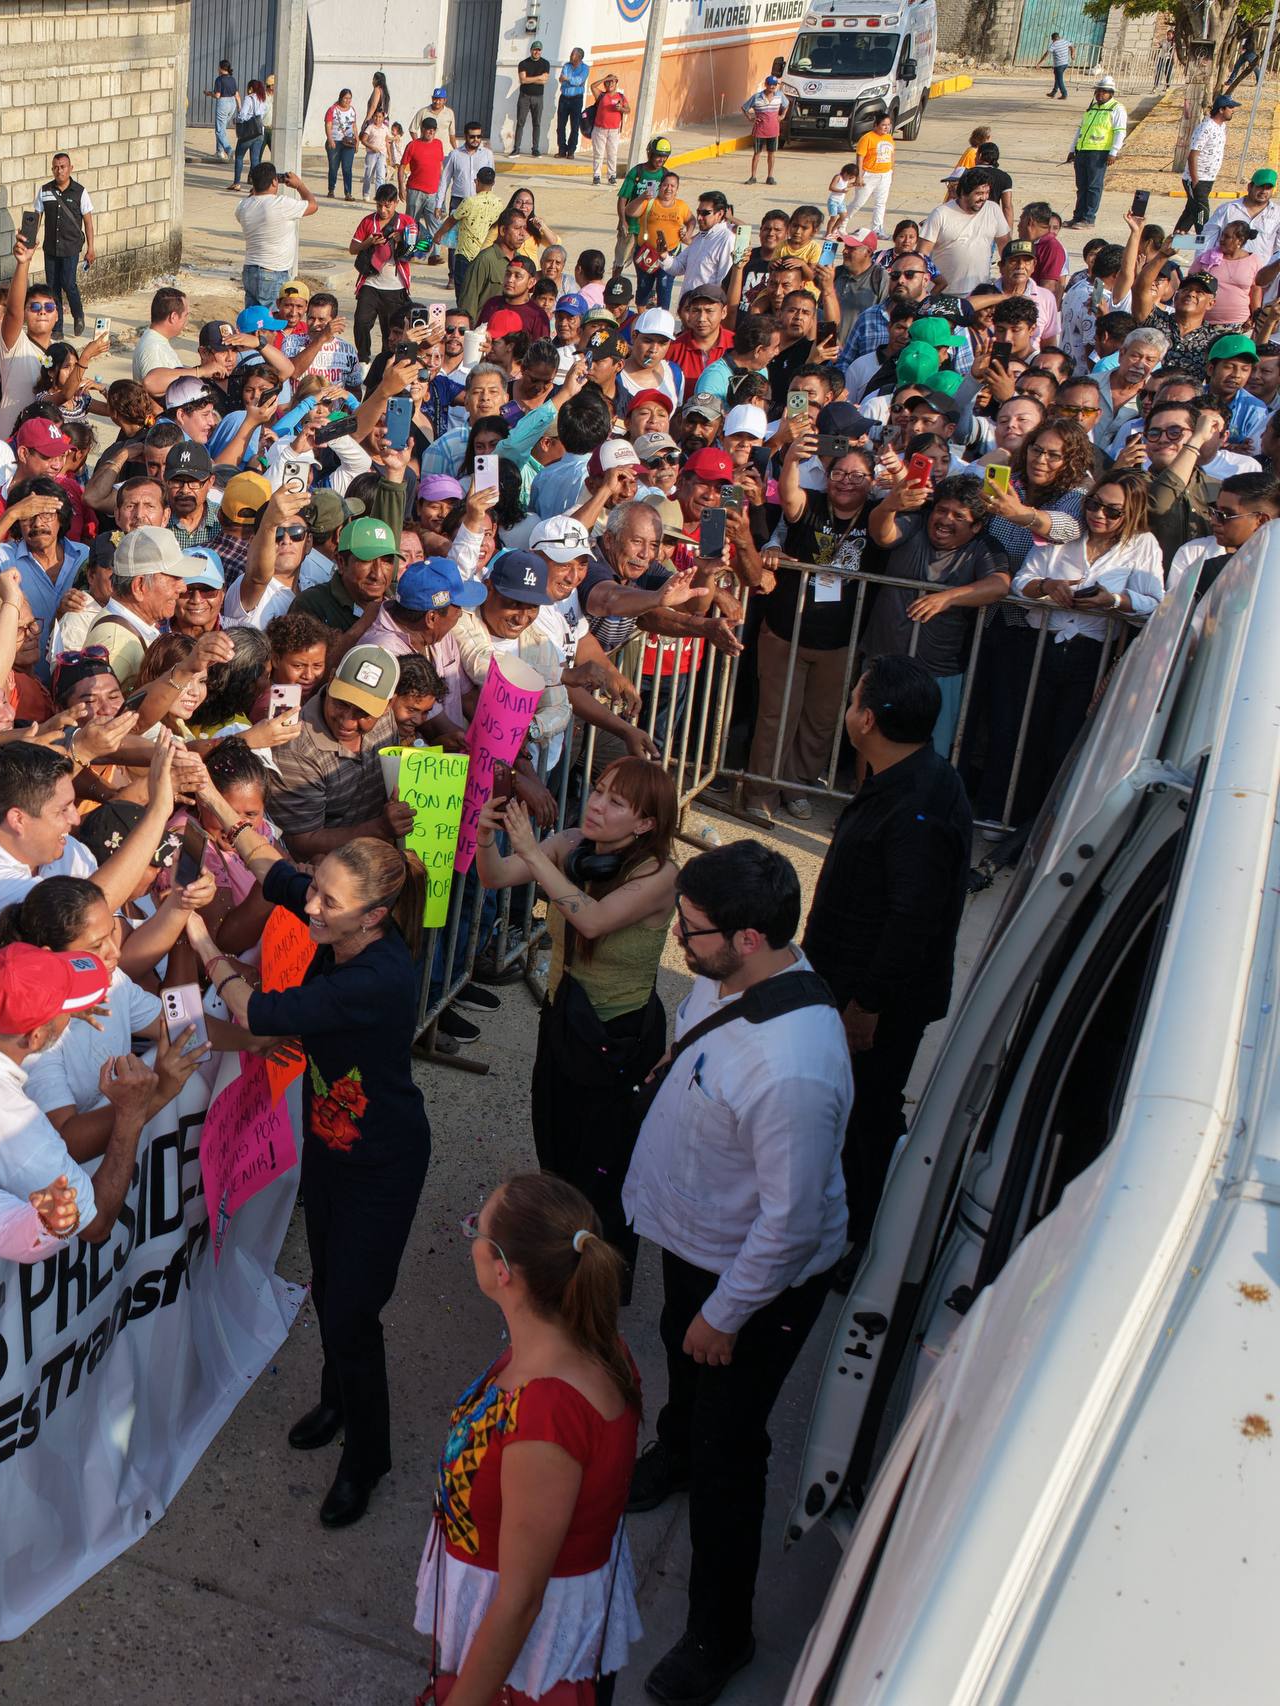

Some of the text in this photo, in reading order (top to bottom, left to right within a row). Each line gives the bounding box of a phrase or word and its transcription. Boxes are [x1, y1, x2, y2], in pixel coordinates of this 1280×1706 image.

[704, 1, 803, 29] MAYOREO Y MENUDEO
[523, 567, 537, 586] LA
[404, 788, 440, 810] CON
[254, 1111, 281, 1145] POR
